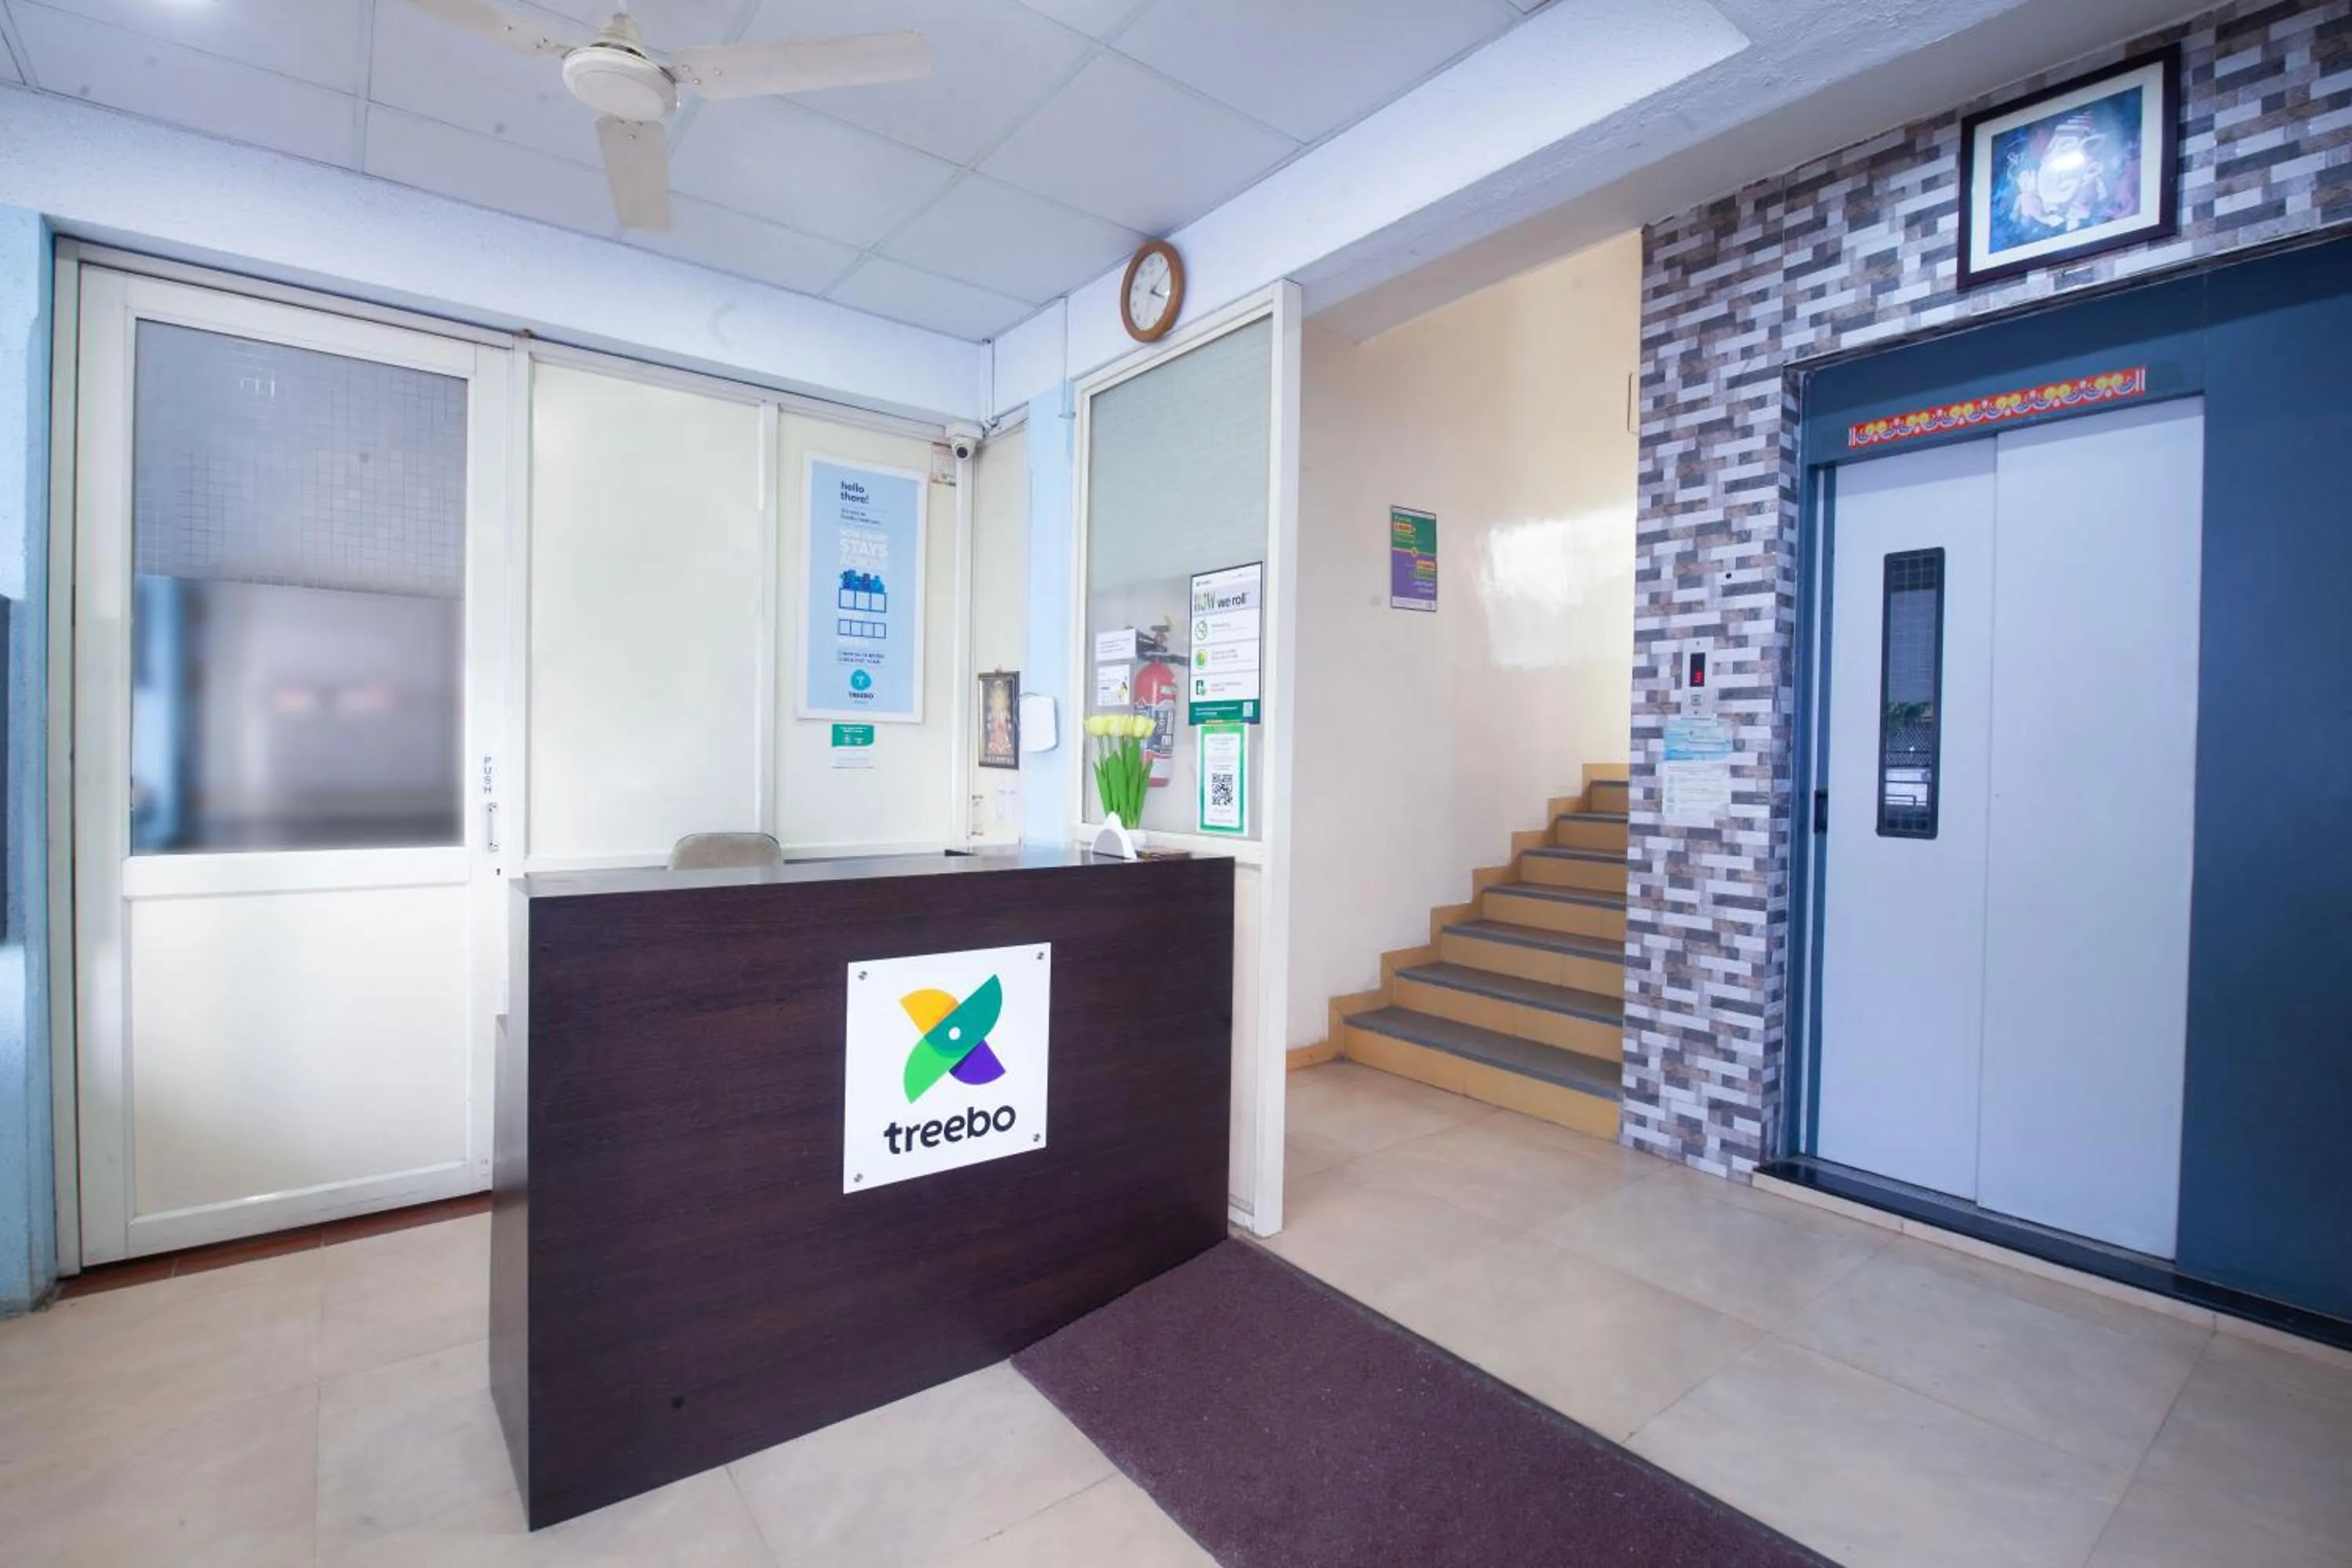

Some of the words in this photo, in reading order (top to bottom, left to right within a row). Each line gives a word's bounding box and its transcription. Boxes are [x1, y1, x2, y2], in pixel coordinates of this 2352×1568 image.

[840, 480, 865, 493] hello
[840, 491, 869, 504] there!
[840, 537, 888, 558] STAYS
[1217, 597, 1232, 608] we
[483, 757, 492, 794] PUSH
[884, 1105, 1017, 1155] treebo
